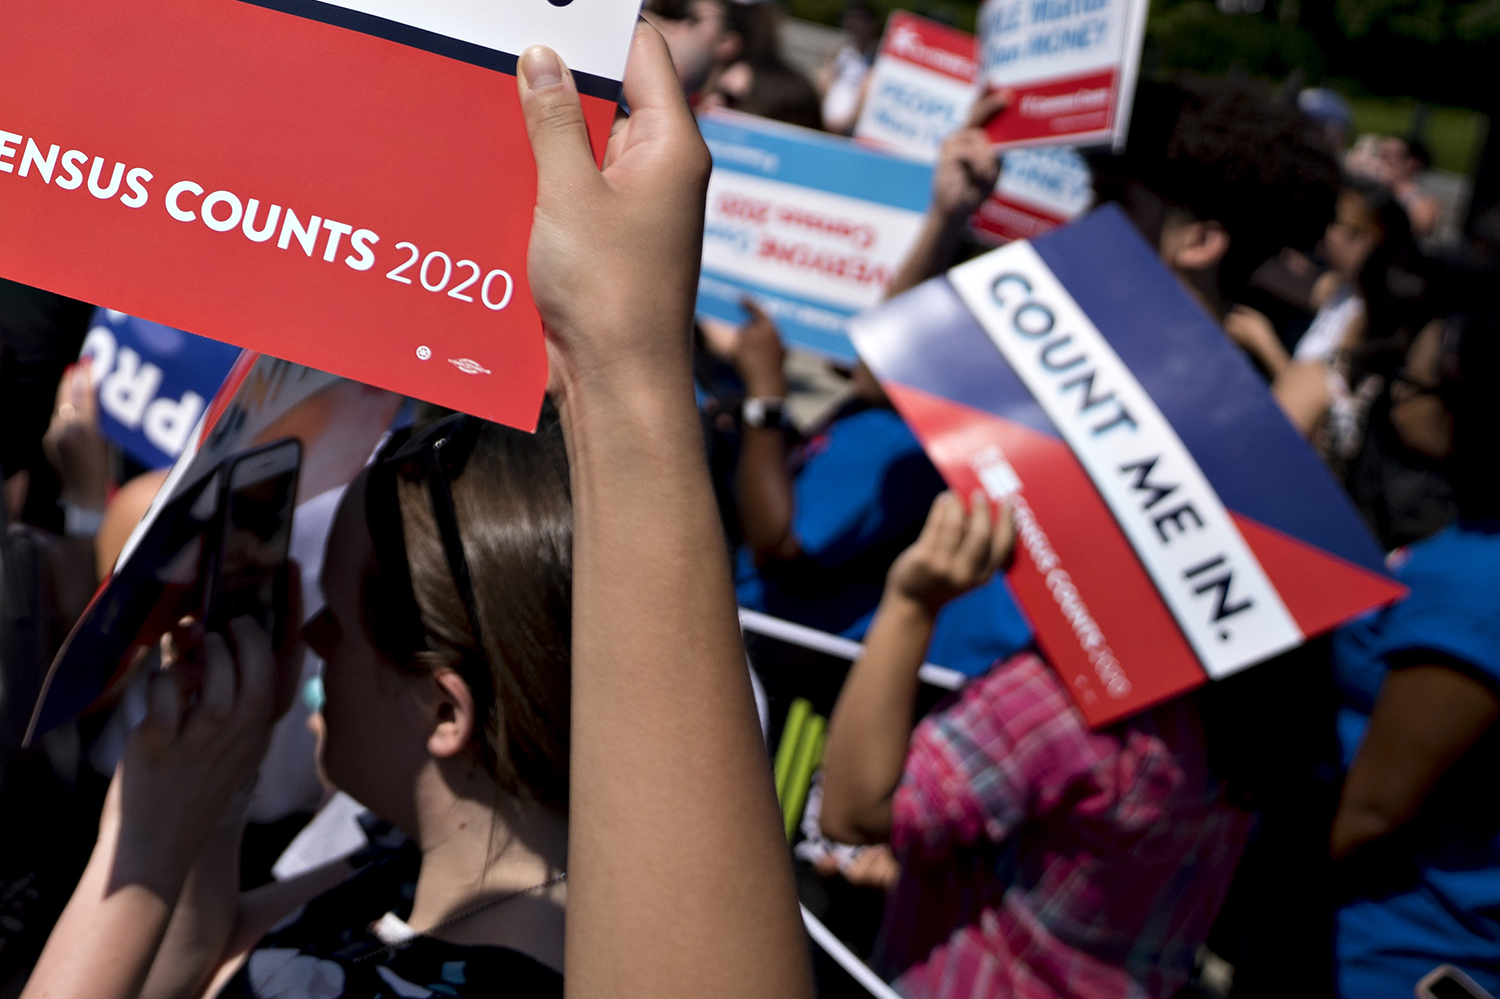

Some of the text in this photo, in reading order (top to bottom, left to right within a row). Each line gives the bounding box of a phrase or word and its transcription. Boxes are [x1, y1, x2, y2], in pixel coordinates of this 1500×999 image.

[165, 180, 380, 271] COUNTS
[385, 241, 513, 310] 2020
[756, 241, 892, 288] VERYONE
[987, 270, 1140, 439] COUNT
[1117, 454, 1208, 548] ME
[1179, 551, 1258, 646] IN.
